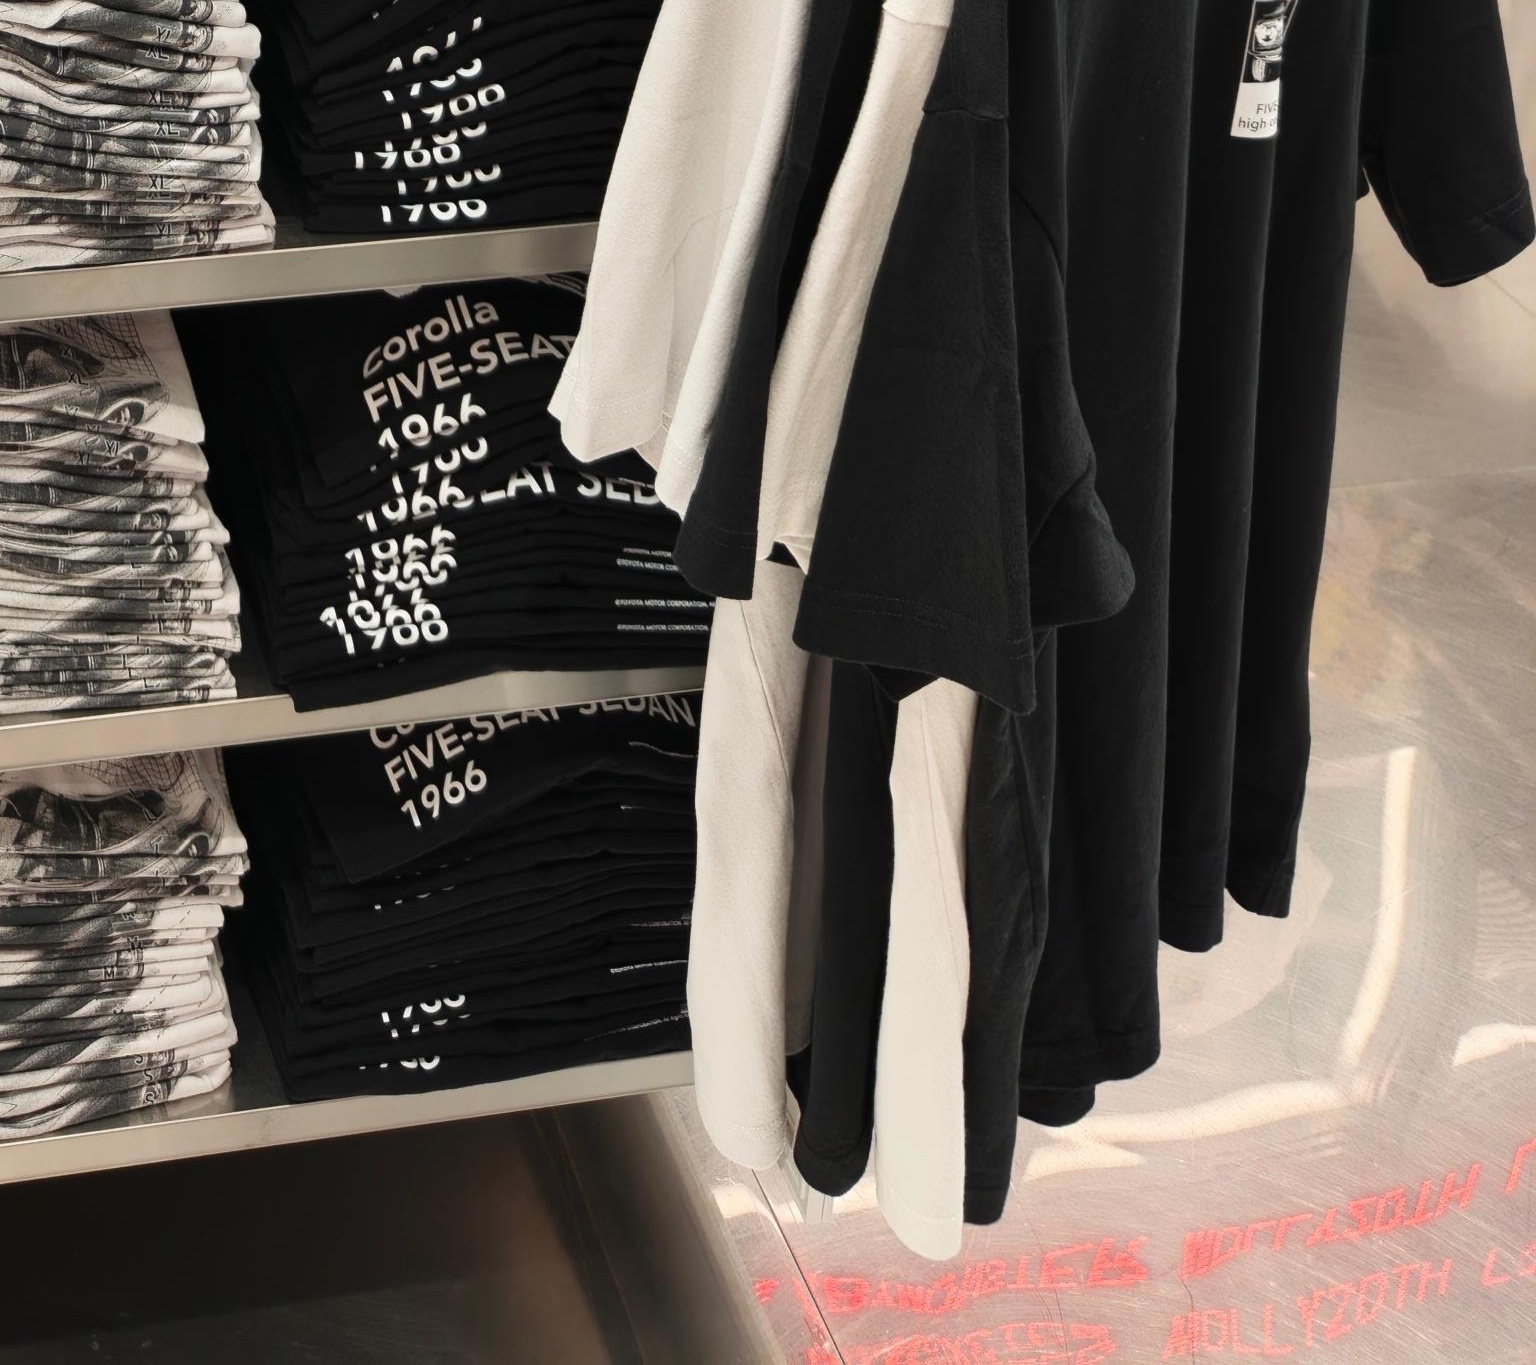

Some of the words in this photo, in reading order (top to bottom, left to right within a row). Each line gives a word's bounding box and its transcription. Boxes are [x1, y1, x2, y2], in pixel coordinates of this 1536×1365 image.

[1237, 117, 1267, 132] high
[363, 294, 500, 378] Corolla
[400, 759, 489, 830] 1966
